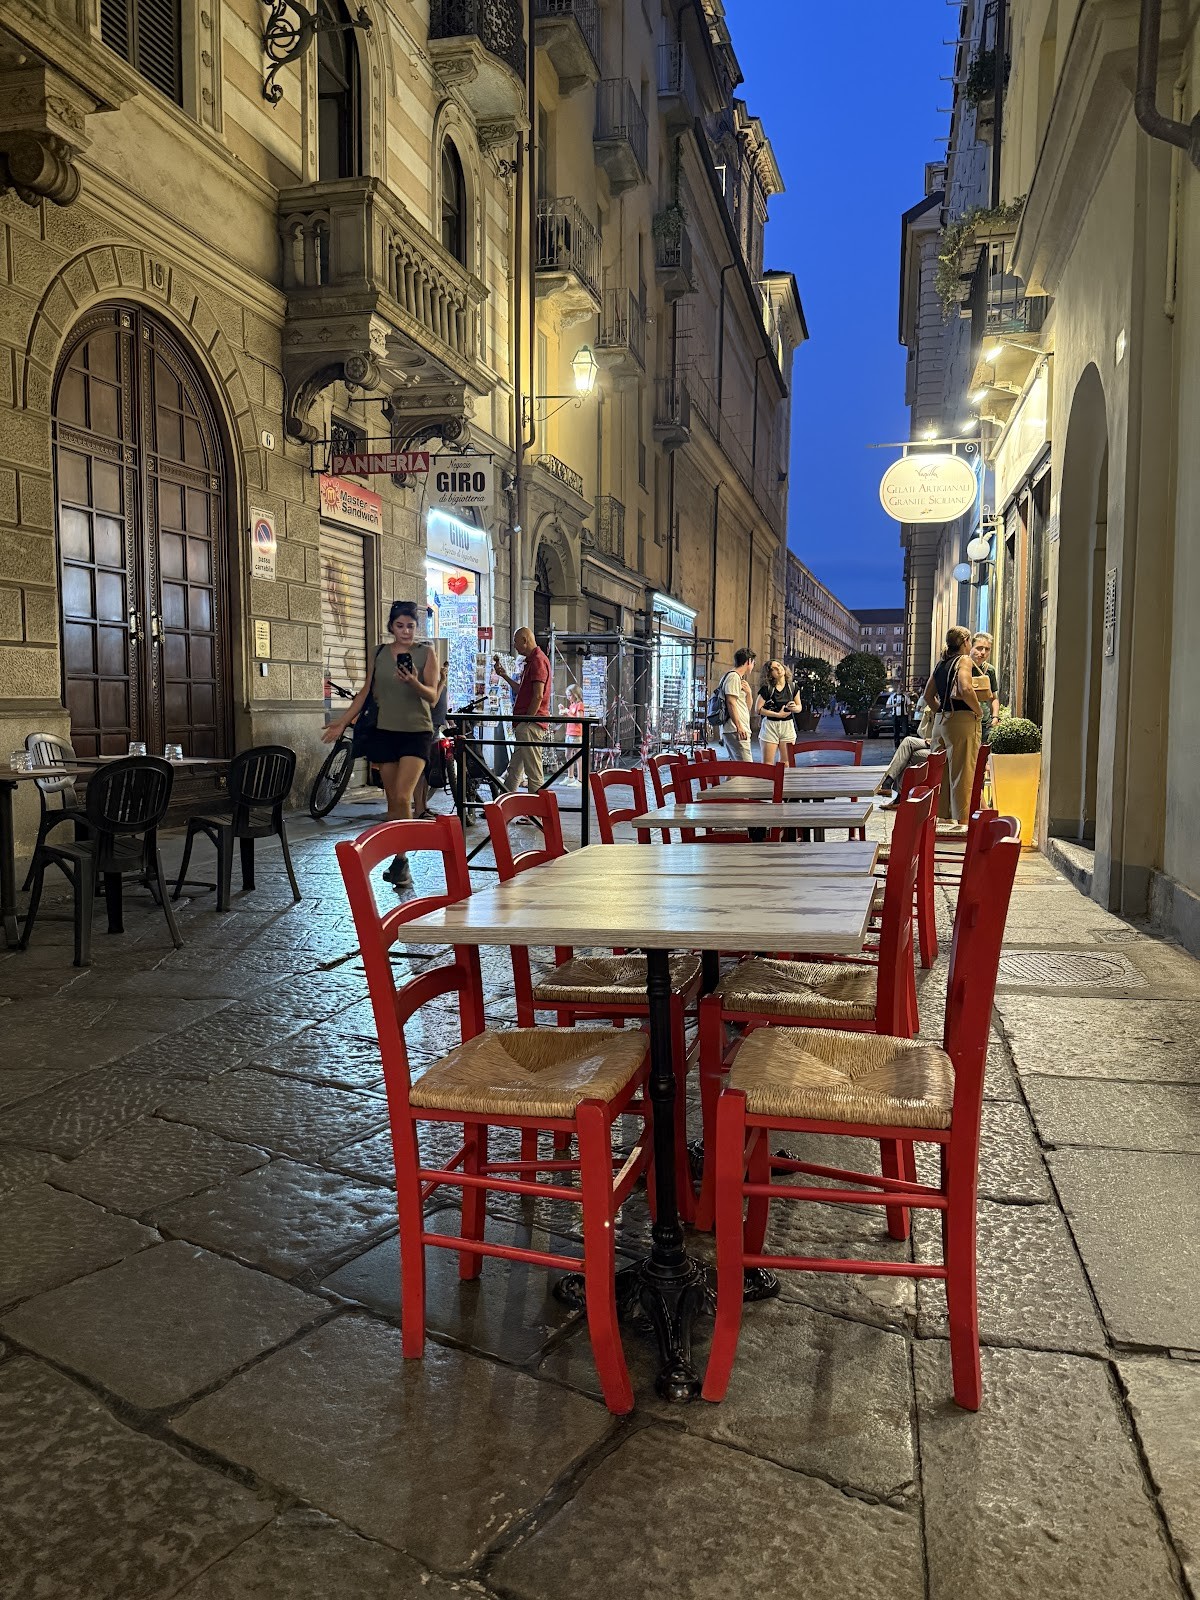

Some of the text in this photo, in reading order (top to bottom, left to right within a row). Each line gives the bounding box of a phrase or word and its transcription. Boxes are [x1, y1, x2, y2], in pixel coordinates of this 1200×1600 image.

[333, 454, 428, 474] PANINERIA
[447, 458, 471, 472] Negozio
[436, 471, 486, 493] GIRO
[340, 489, 368, 509] Master
[438, 493, 486, 506] di bigiotteria
[341, 501, 379, 526] Sandwich
[449, 521, 470, 551] GIRO
